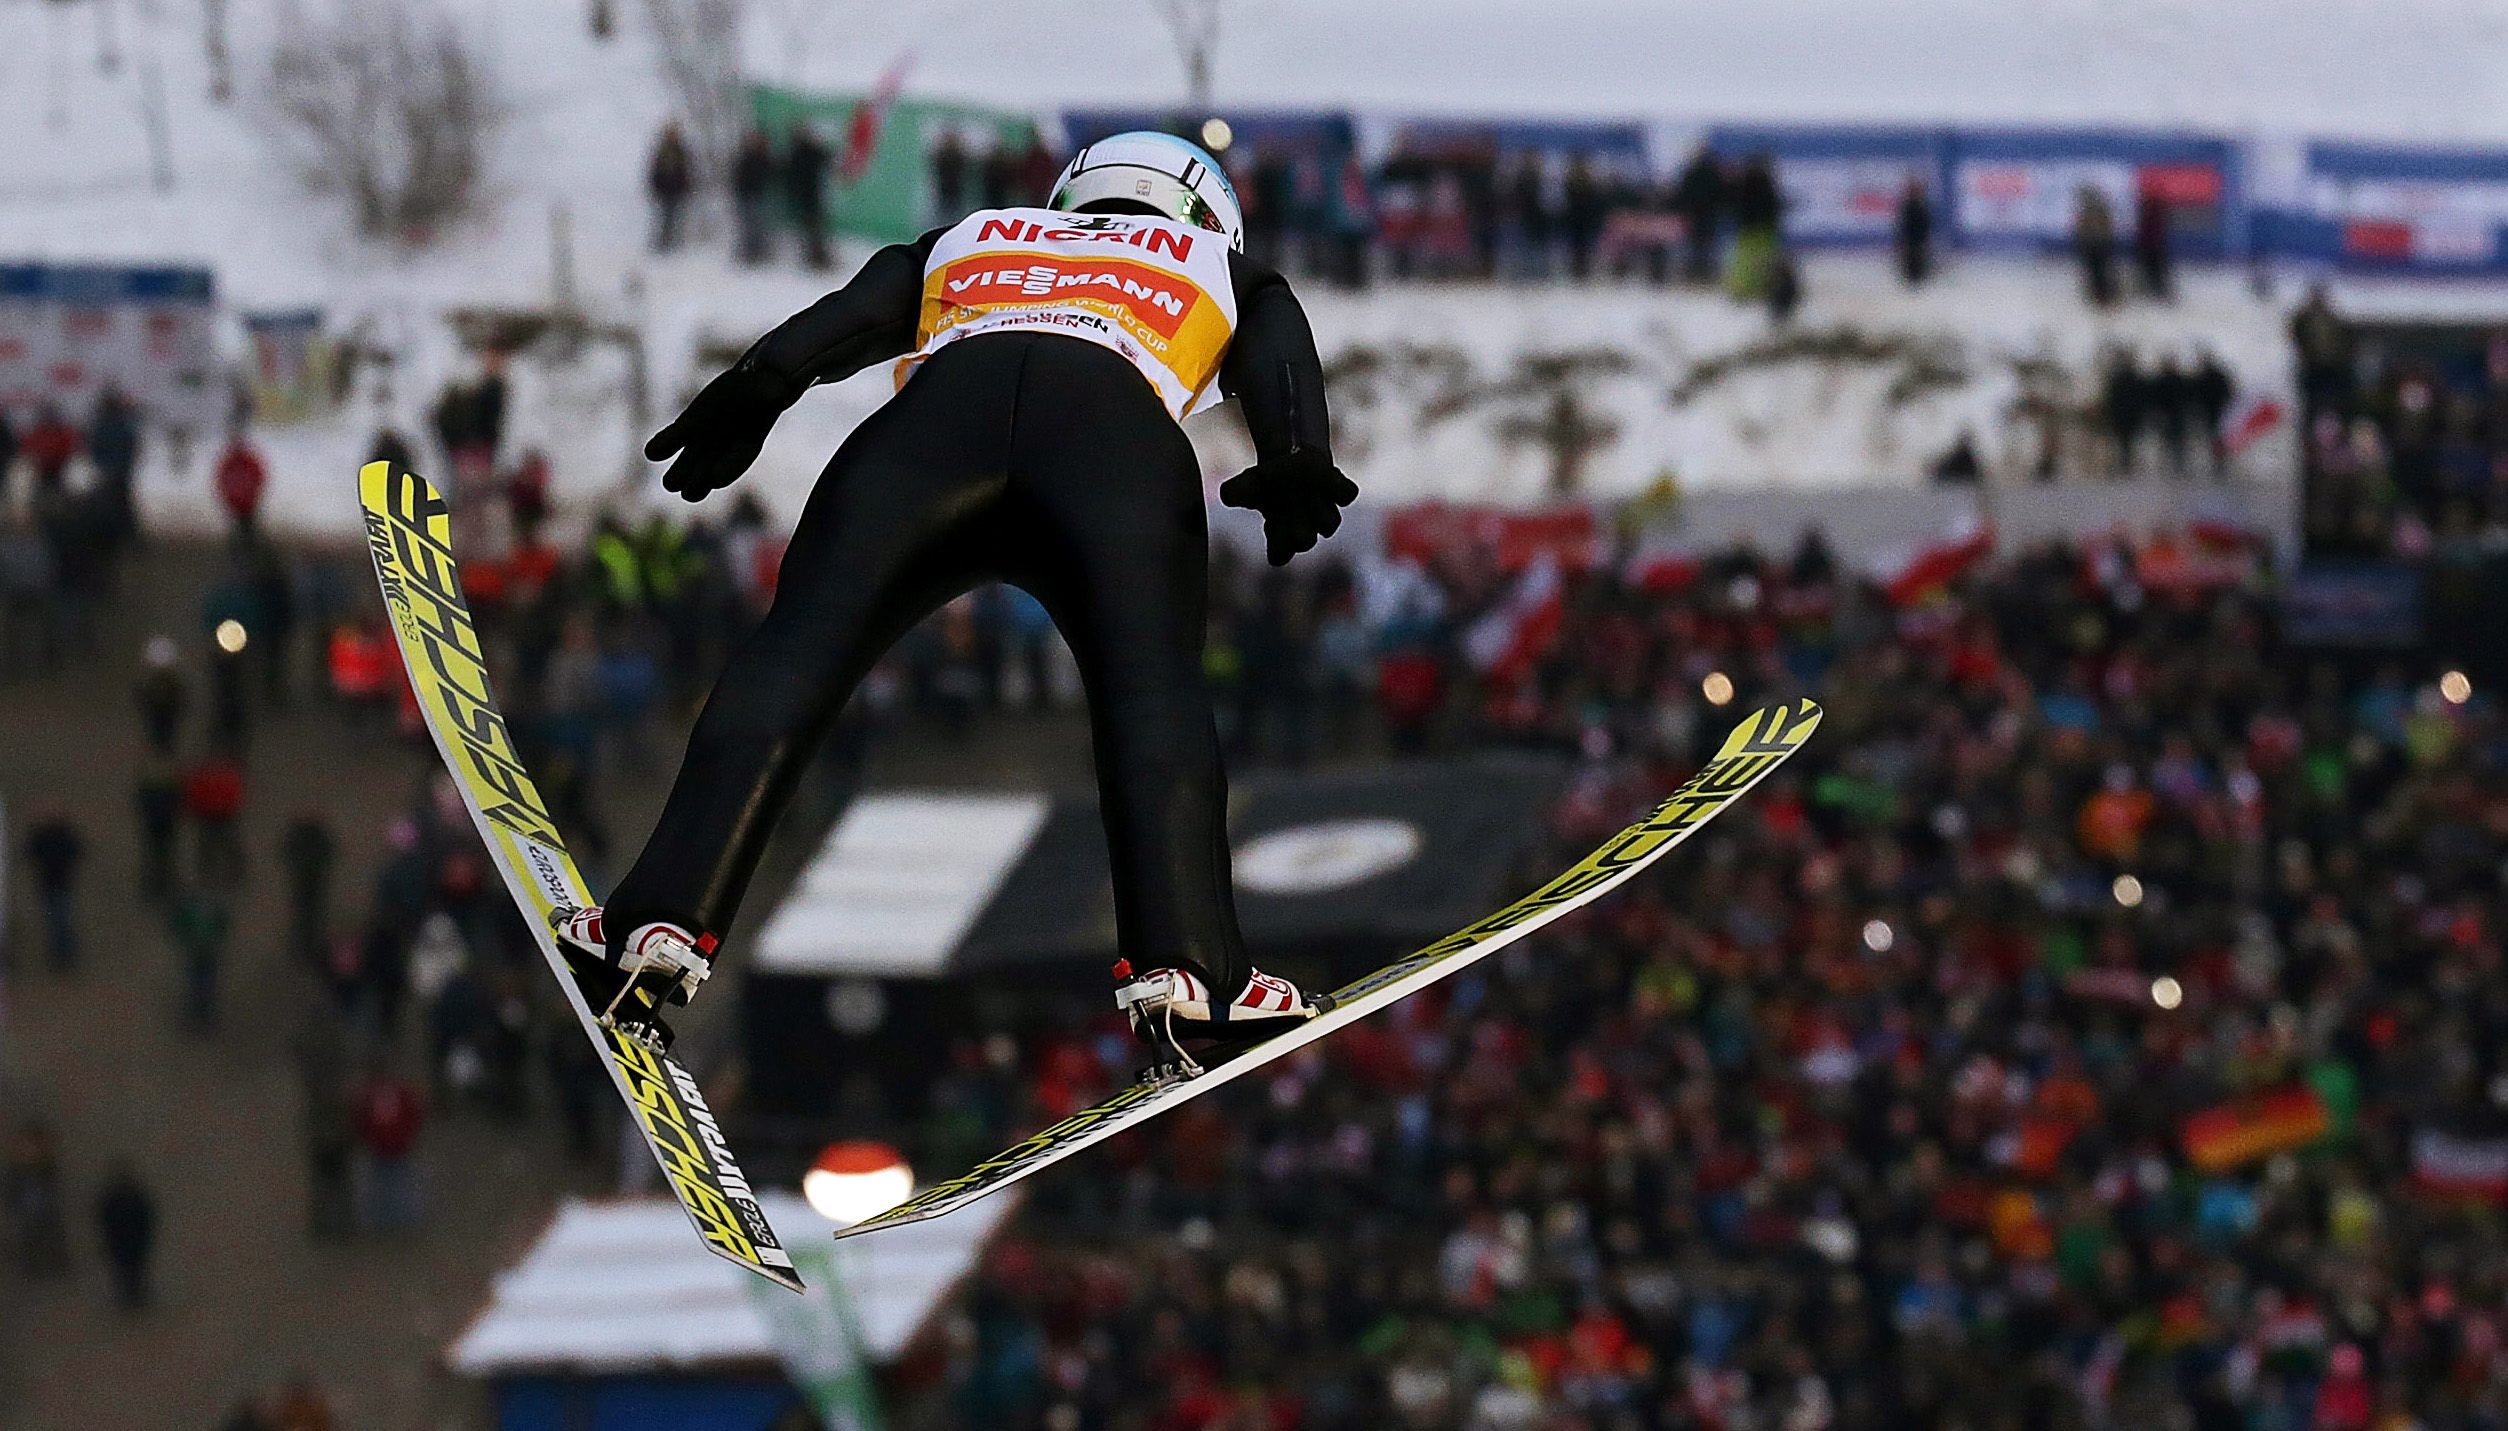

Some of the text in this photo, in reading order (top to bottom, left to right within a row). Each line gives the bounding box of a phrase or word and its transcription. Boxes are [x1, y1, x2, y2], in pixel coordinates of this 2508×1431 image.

[948, 265, 1184, 317] VIESSMANN
[1137, 327, 1169, 353] CUP
[387, 460, 553, 820] FISCHER
[1468, 702, 1820, 937] FISCHER
[611, 1028, 761, 1266] FISCHER
